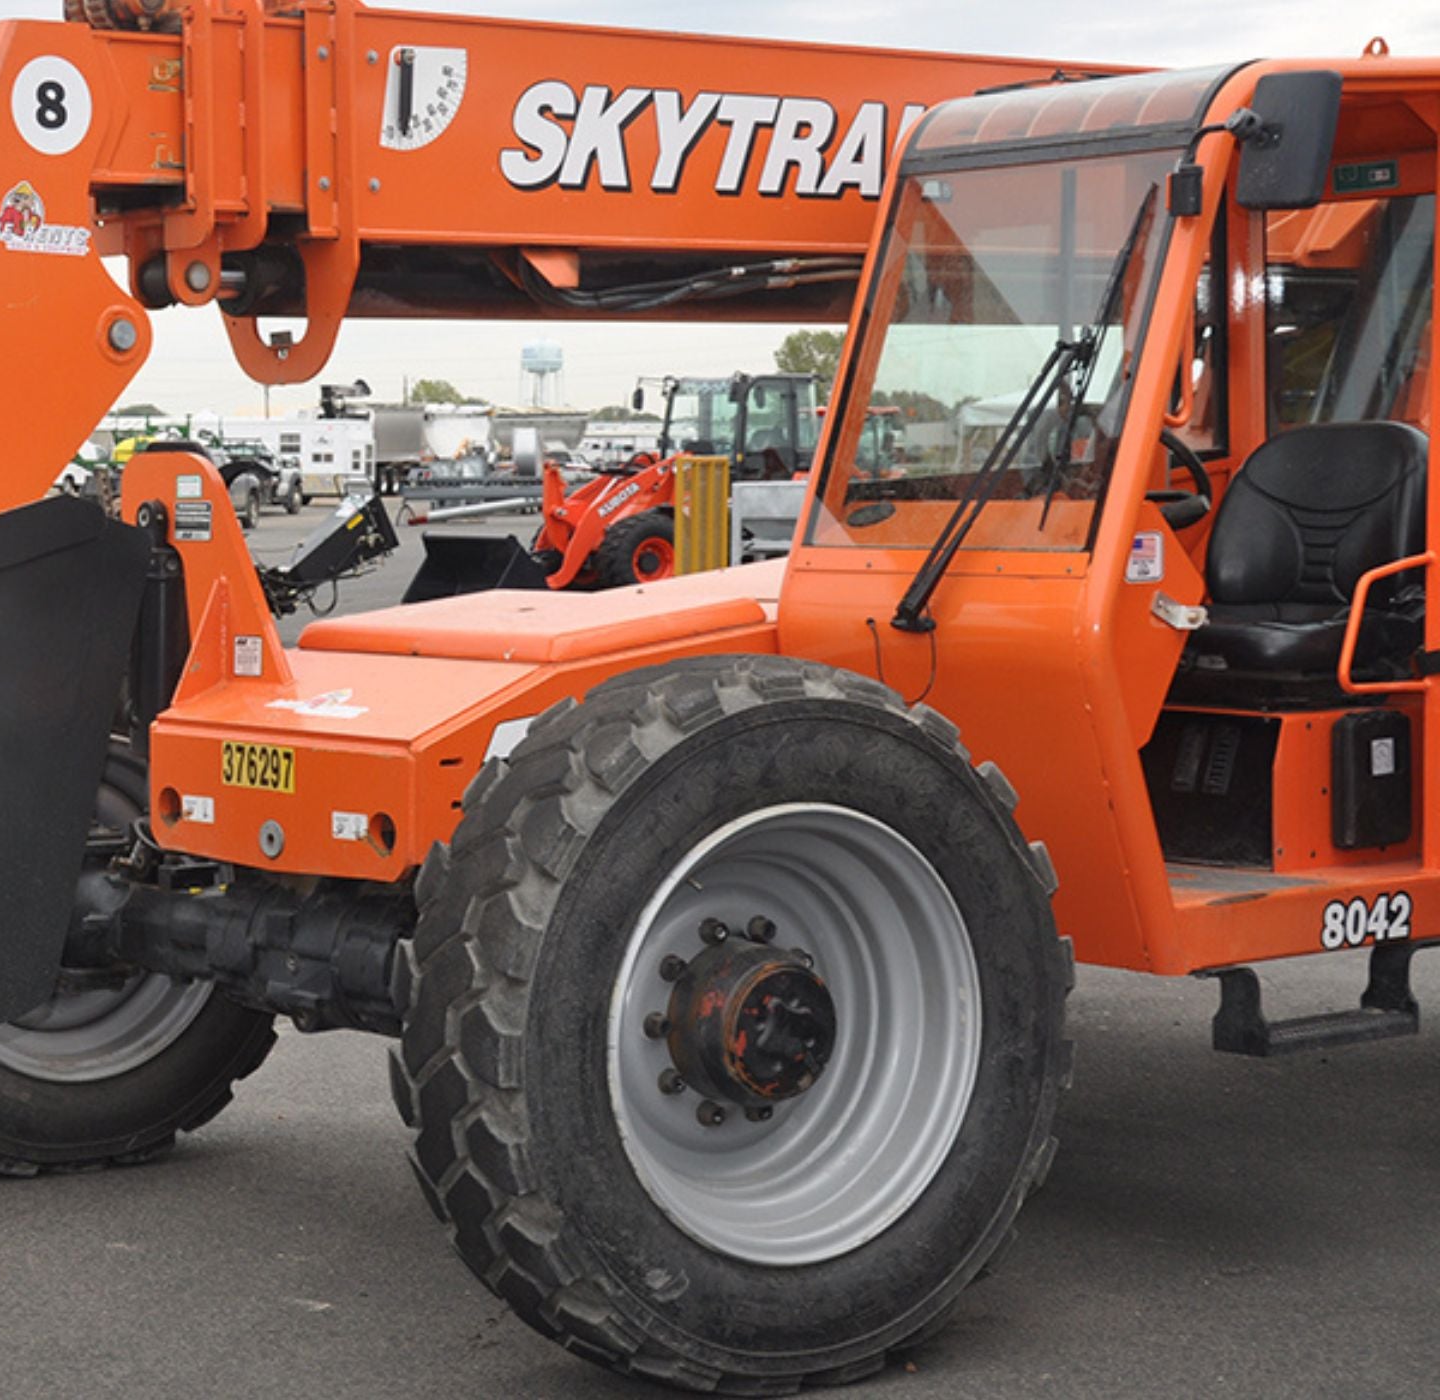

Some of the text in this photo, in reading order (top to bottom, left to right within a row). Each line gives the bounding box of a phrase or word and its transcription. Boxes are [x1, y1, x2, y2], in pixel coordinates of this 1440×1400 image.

[35, 79, 68, 130] 8
[499, 79, 929, 198] SKYTRA
[222, 743, 293, 790] 376297
[1321, 890, 1412, 950] 8042
